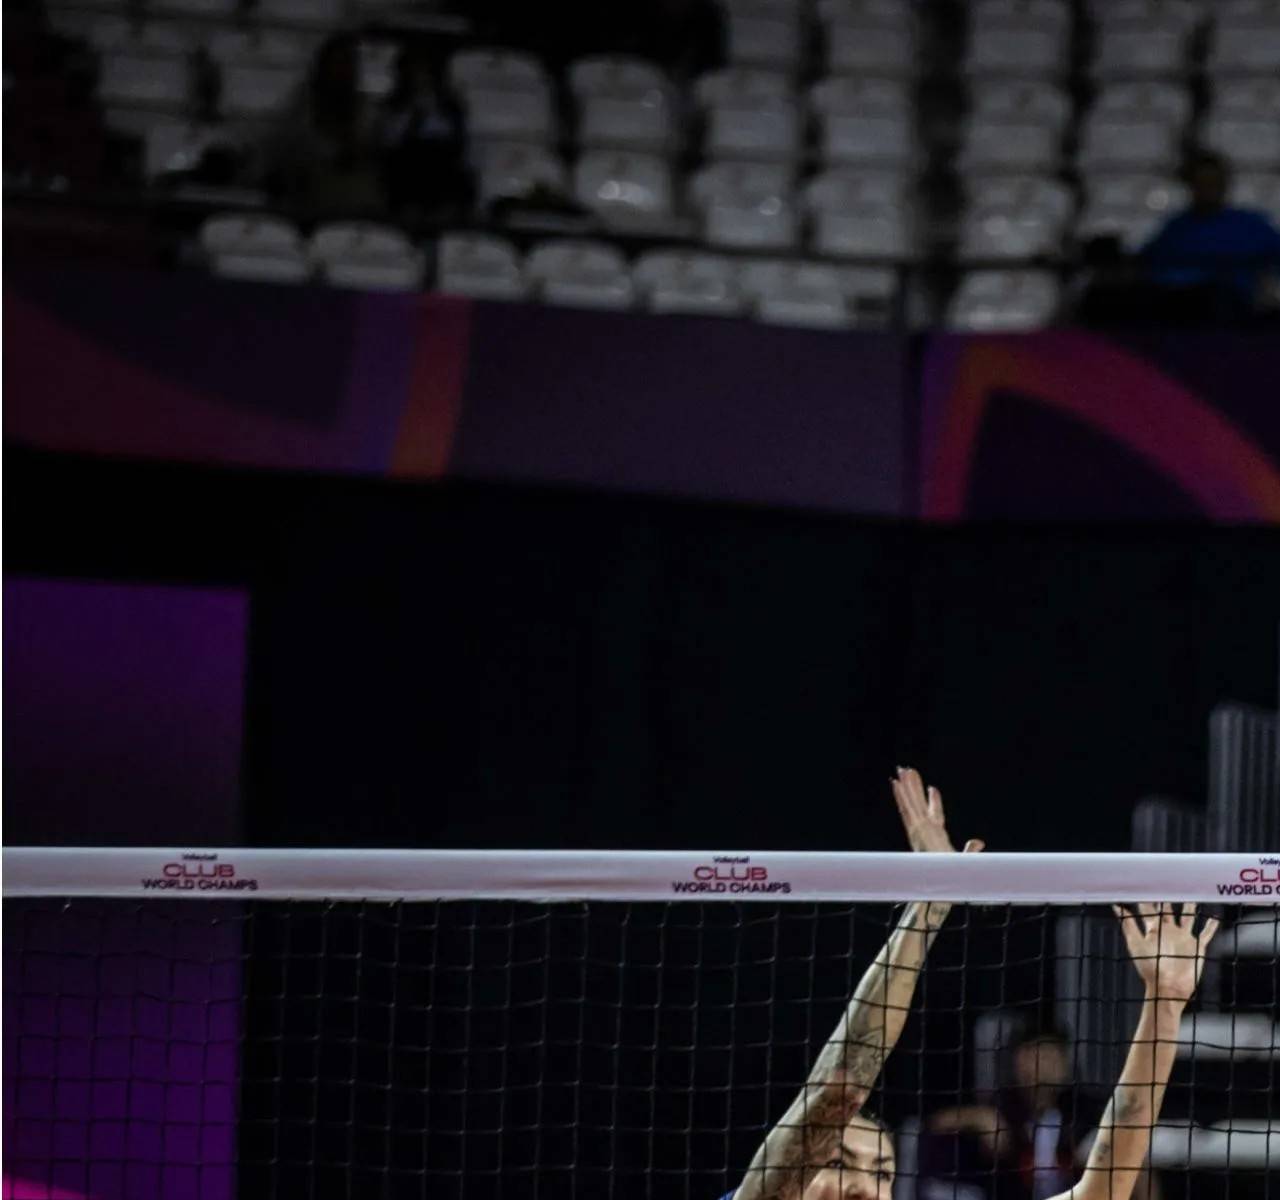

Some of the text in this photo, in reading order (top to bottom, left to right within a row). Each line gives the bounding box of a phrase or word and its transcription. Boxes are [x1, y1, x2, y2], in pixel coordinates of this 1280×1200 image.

[163, 863, 235, 878] CLUB
[694, 866, 768, 881] CLUB
[141, 878, 258, 891] WORLD CHAMPS
[672, 881, 792, 894] WORLD CHAMPS
[1217, 884, 1273, 896] WORLD
